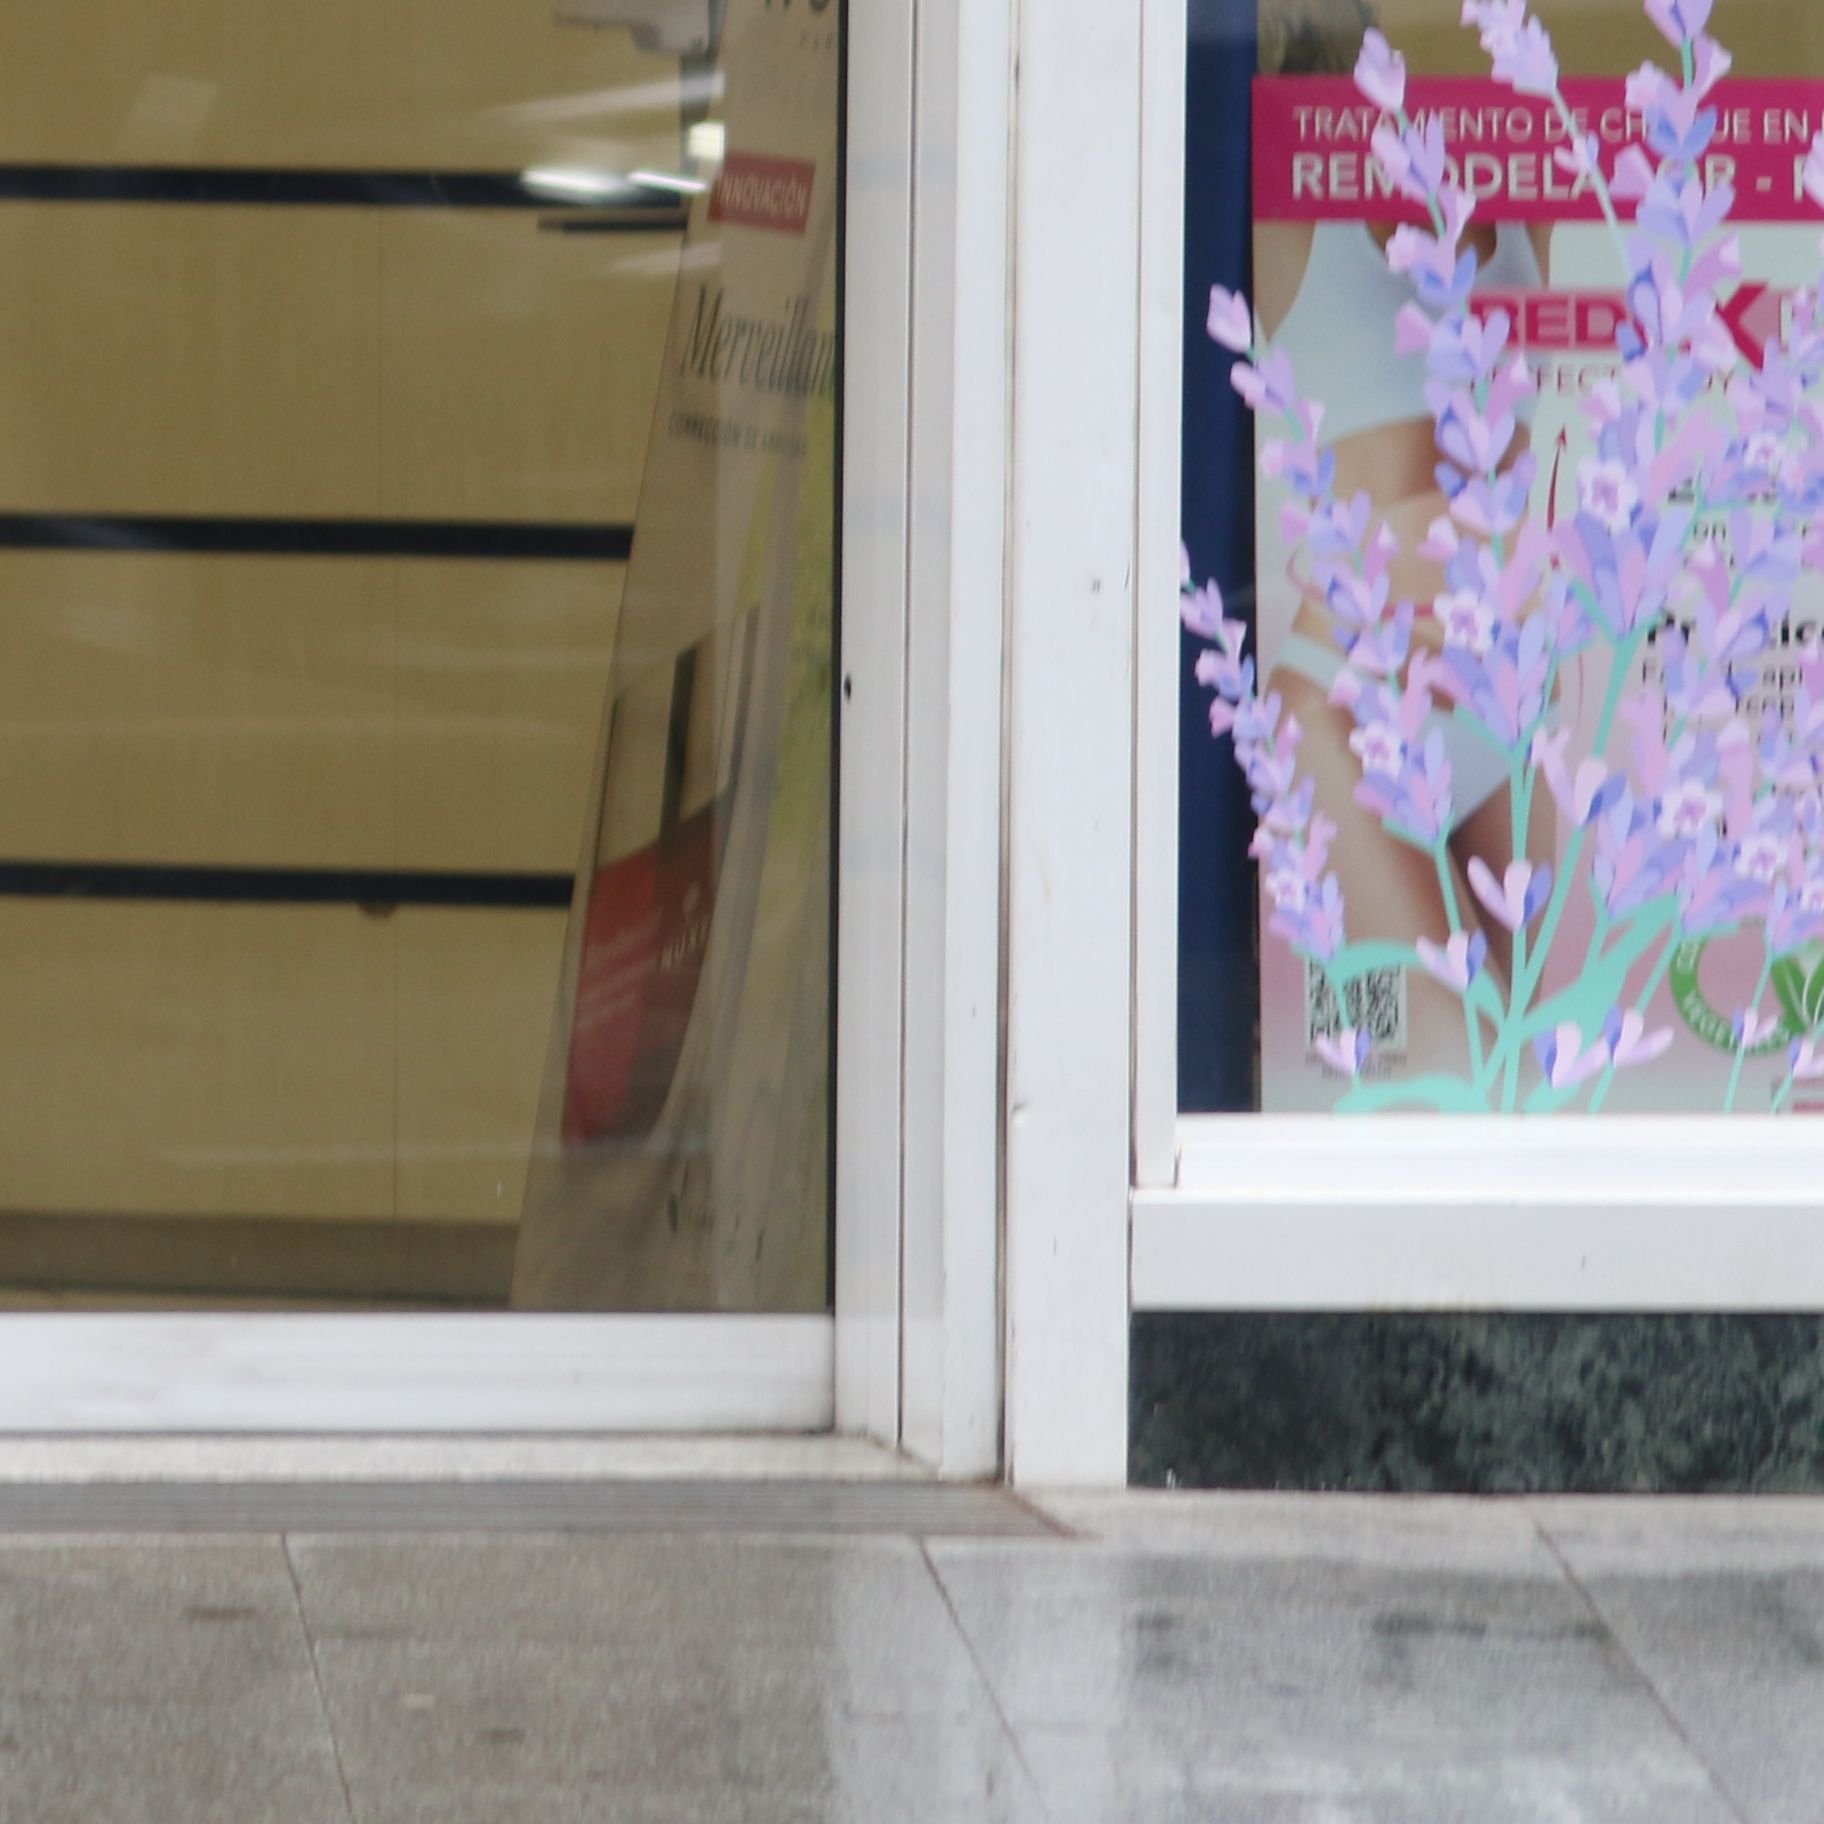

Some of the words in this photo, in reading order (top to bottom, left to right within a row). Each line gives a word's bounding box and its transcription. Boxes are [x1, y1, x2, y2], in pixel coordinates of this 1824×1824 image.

[1292, 105, 1534, 144] TRATMENTO
[1544, 106, 1589, 144] DE
[1601, 106, 1752, 145] CHUE
[1762, 107, 1809, 144] EN
[1291, 151, 1736, 203] REMDELAR
